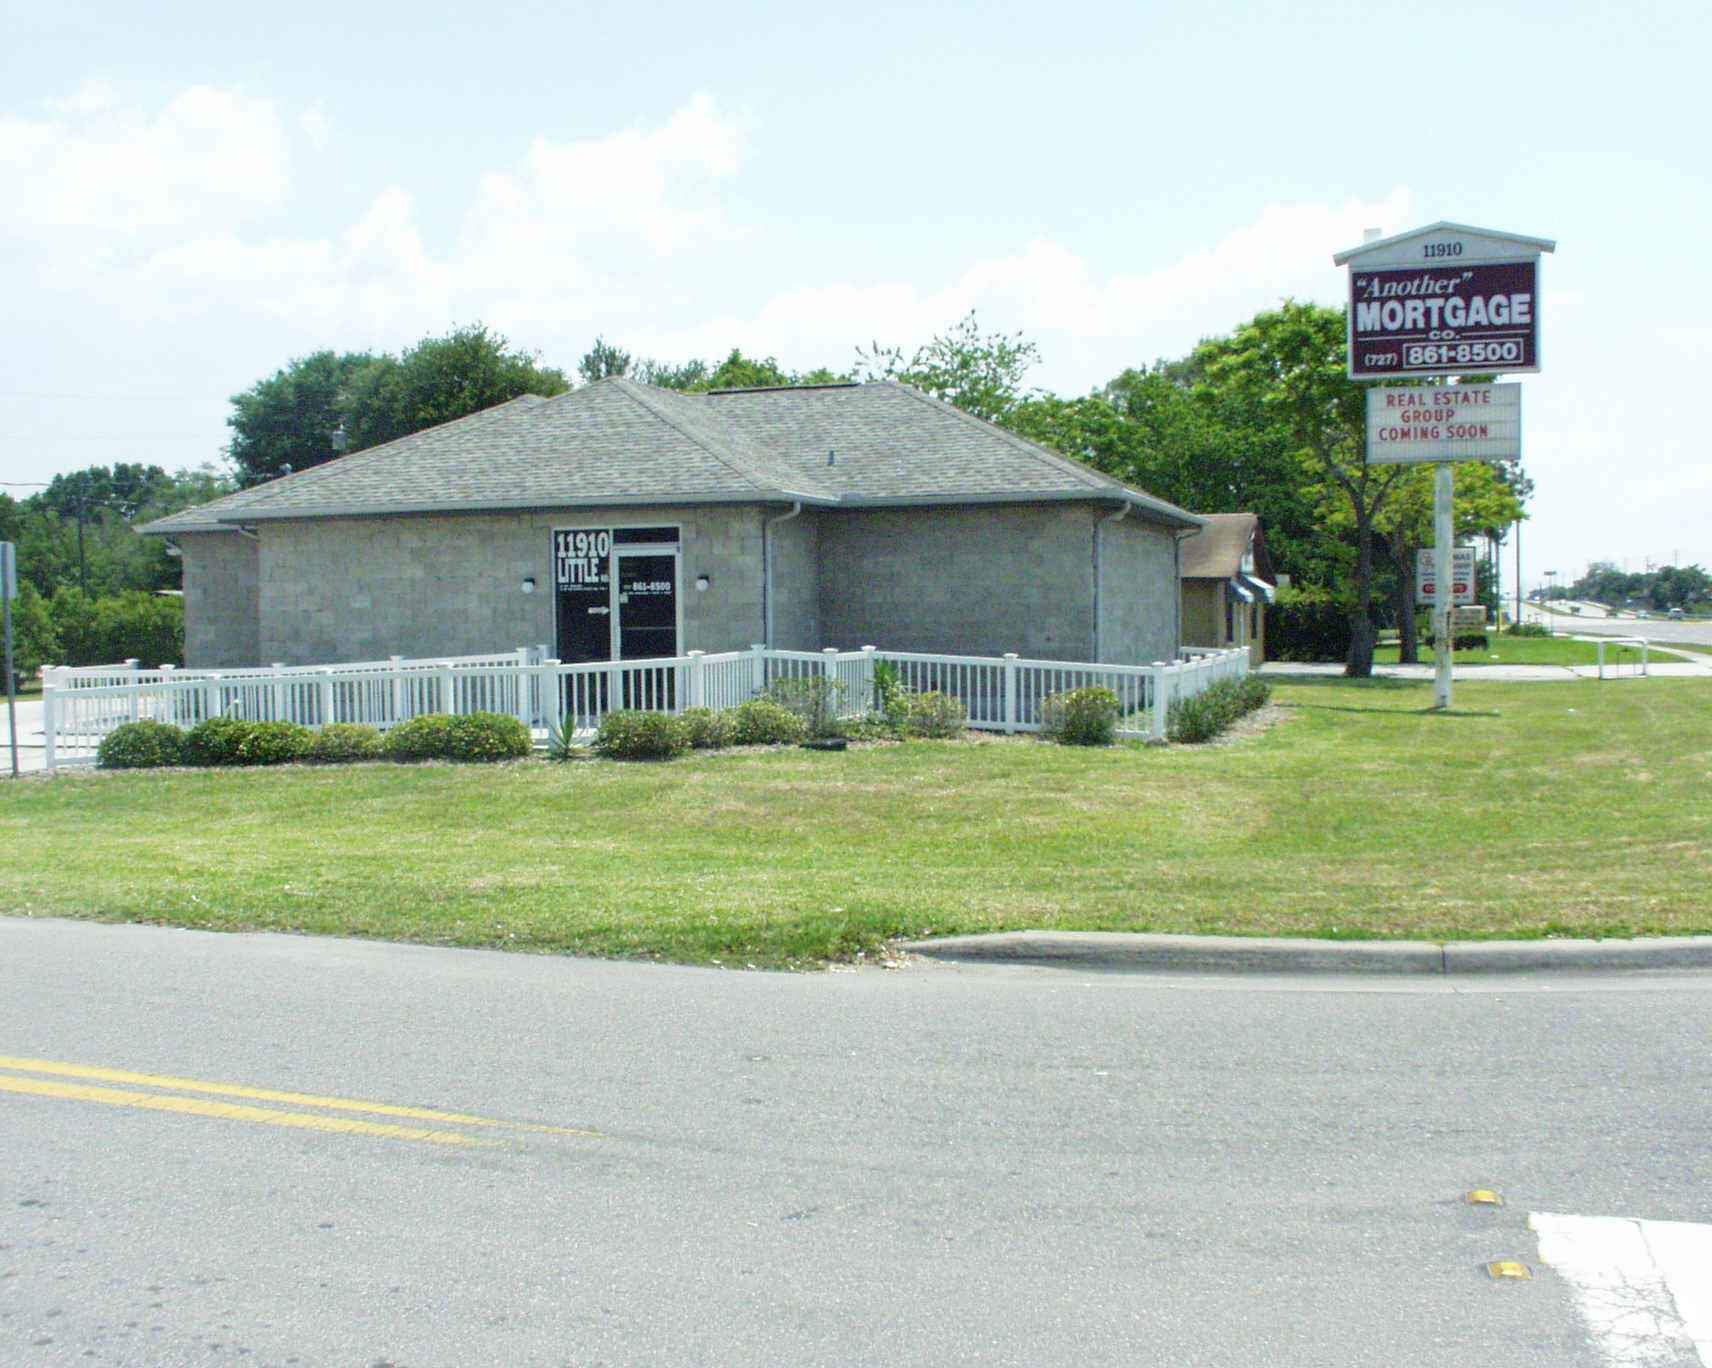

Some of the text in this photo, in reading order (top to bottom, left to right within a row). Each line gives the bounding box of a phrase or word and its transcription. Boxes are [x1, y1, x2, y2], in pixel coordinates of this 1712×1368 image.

[1423, 242, 1462, 258] 11910
[1356, 293, 1531, 332] MORTGAGE
[1364, 343, 1518, 367] (727) 861-8500
[1386, 390, 1491, 406] REAL ESTATE
[1401, 409, 1456, 423] GROUP
[1378, 425, 1489, 441] COMING SOON
[557, 532, 609, 558] 11910
[557, 558, 599, 584] LITTLE
